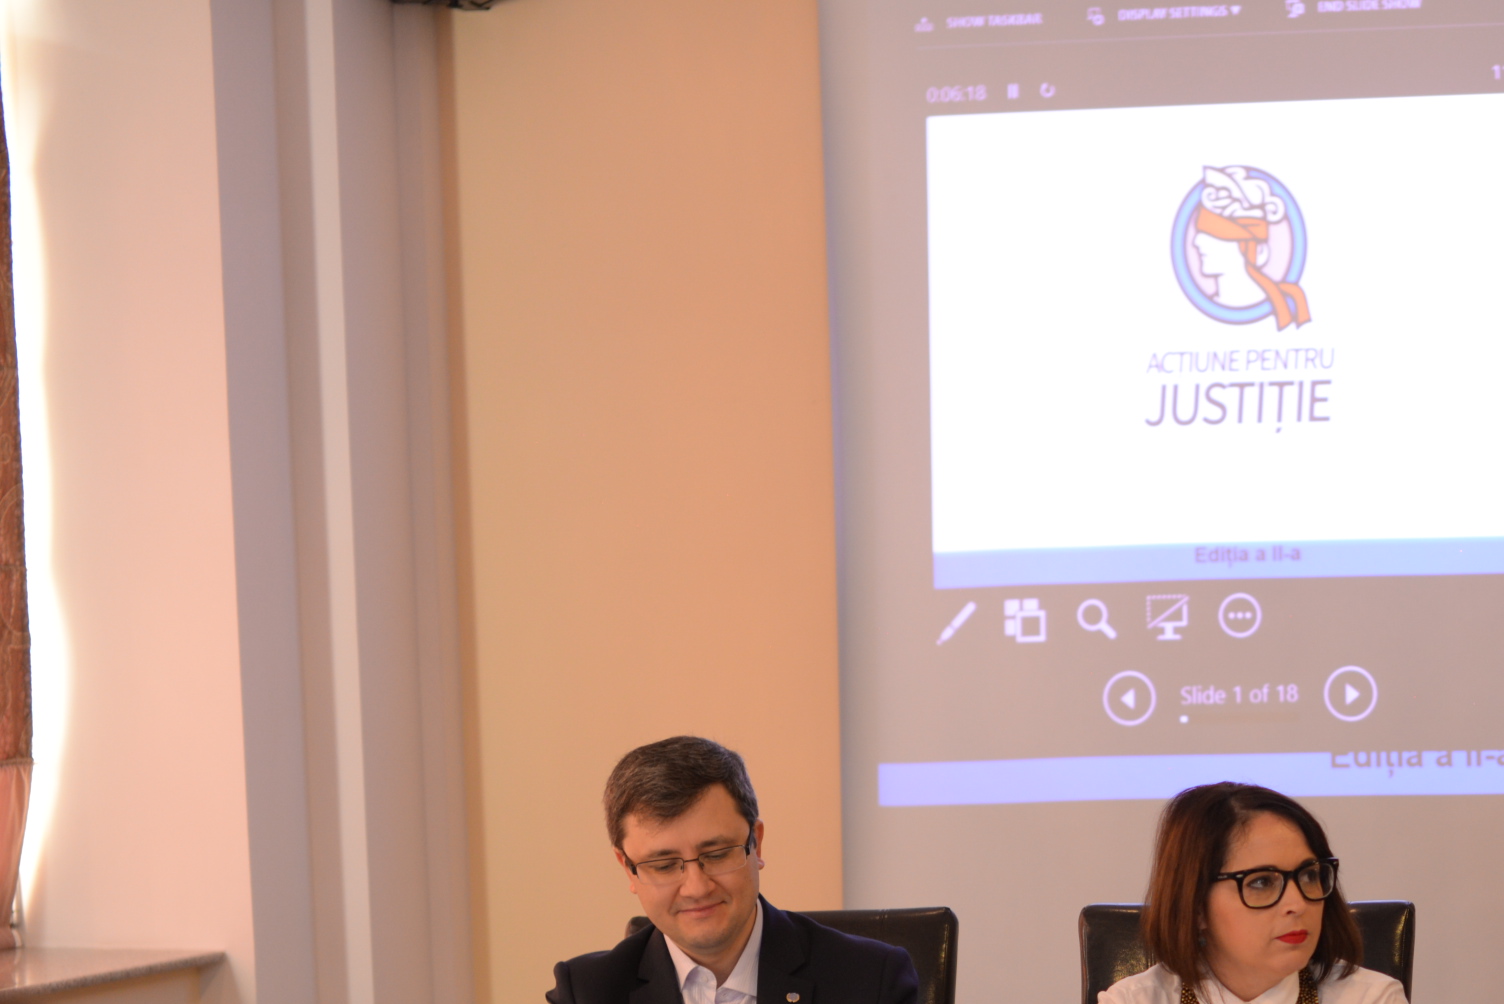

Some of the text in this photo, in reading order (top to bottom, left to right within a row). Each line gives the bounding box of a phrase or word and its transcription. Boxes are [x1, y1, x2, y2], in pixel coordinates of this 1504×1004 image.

[1246, 347, 1335, 371] PENTRU
[1145, 379, 1332, 434] JUSTIȚIE
[1256, 549, 1266, 561] a
[1180, 683, 1299, 705] Slide 1 of 18
